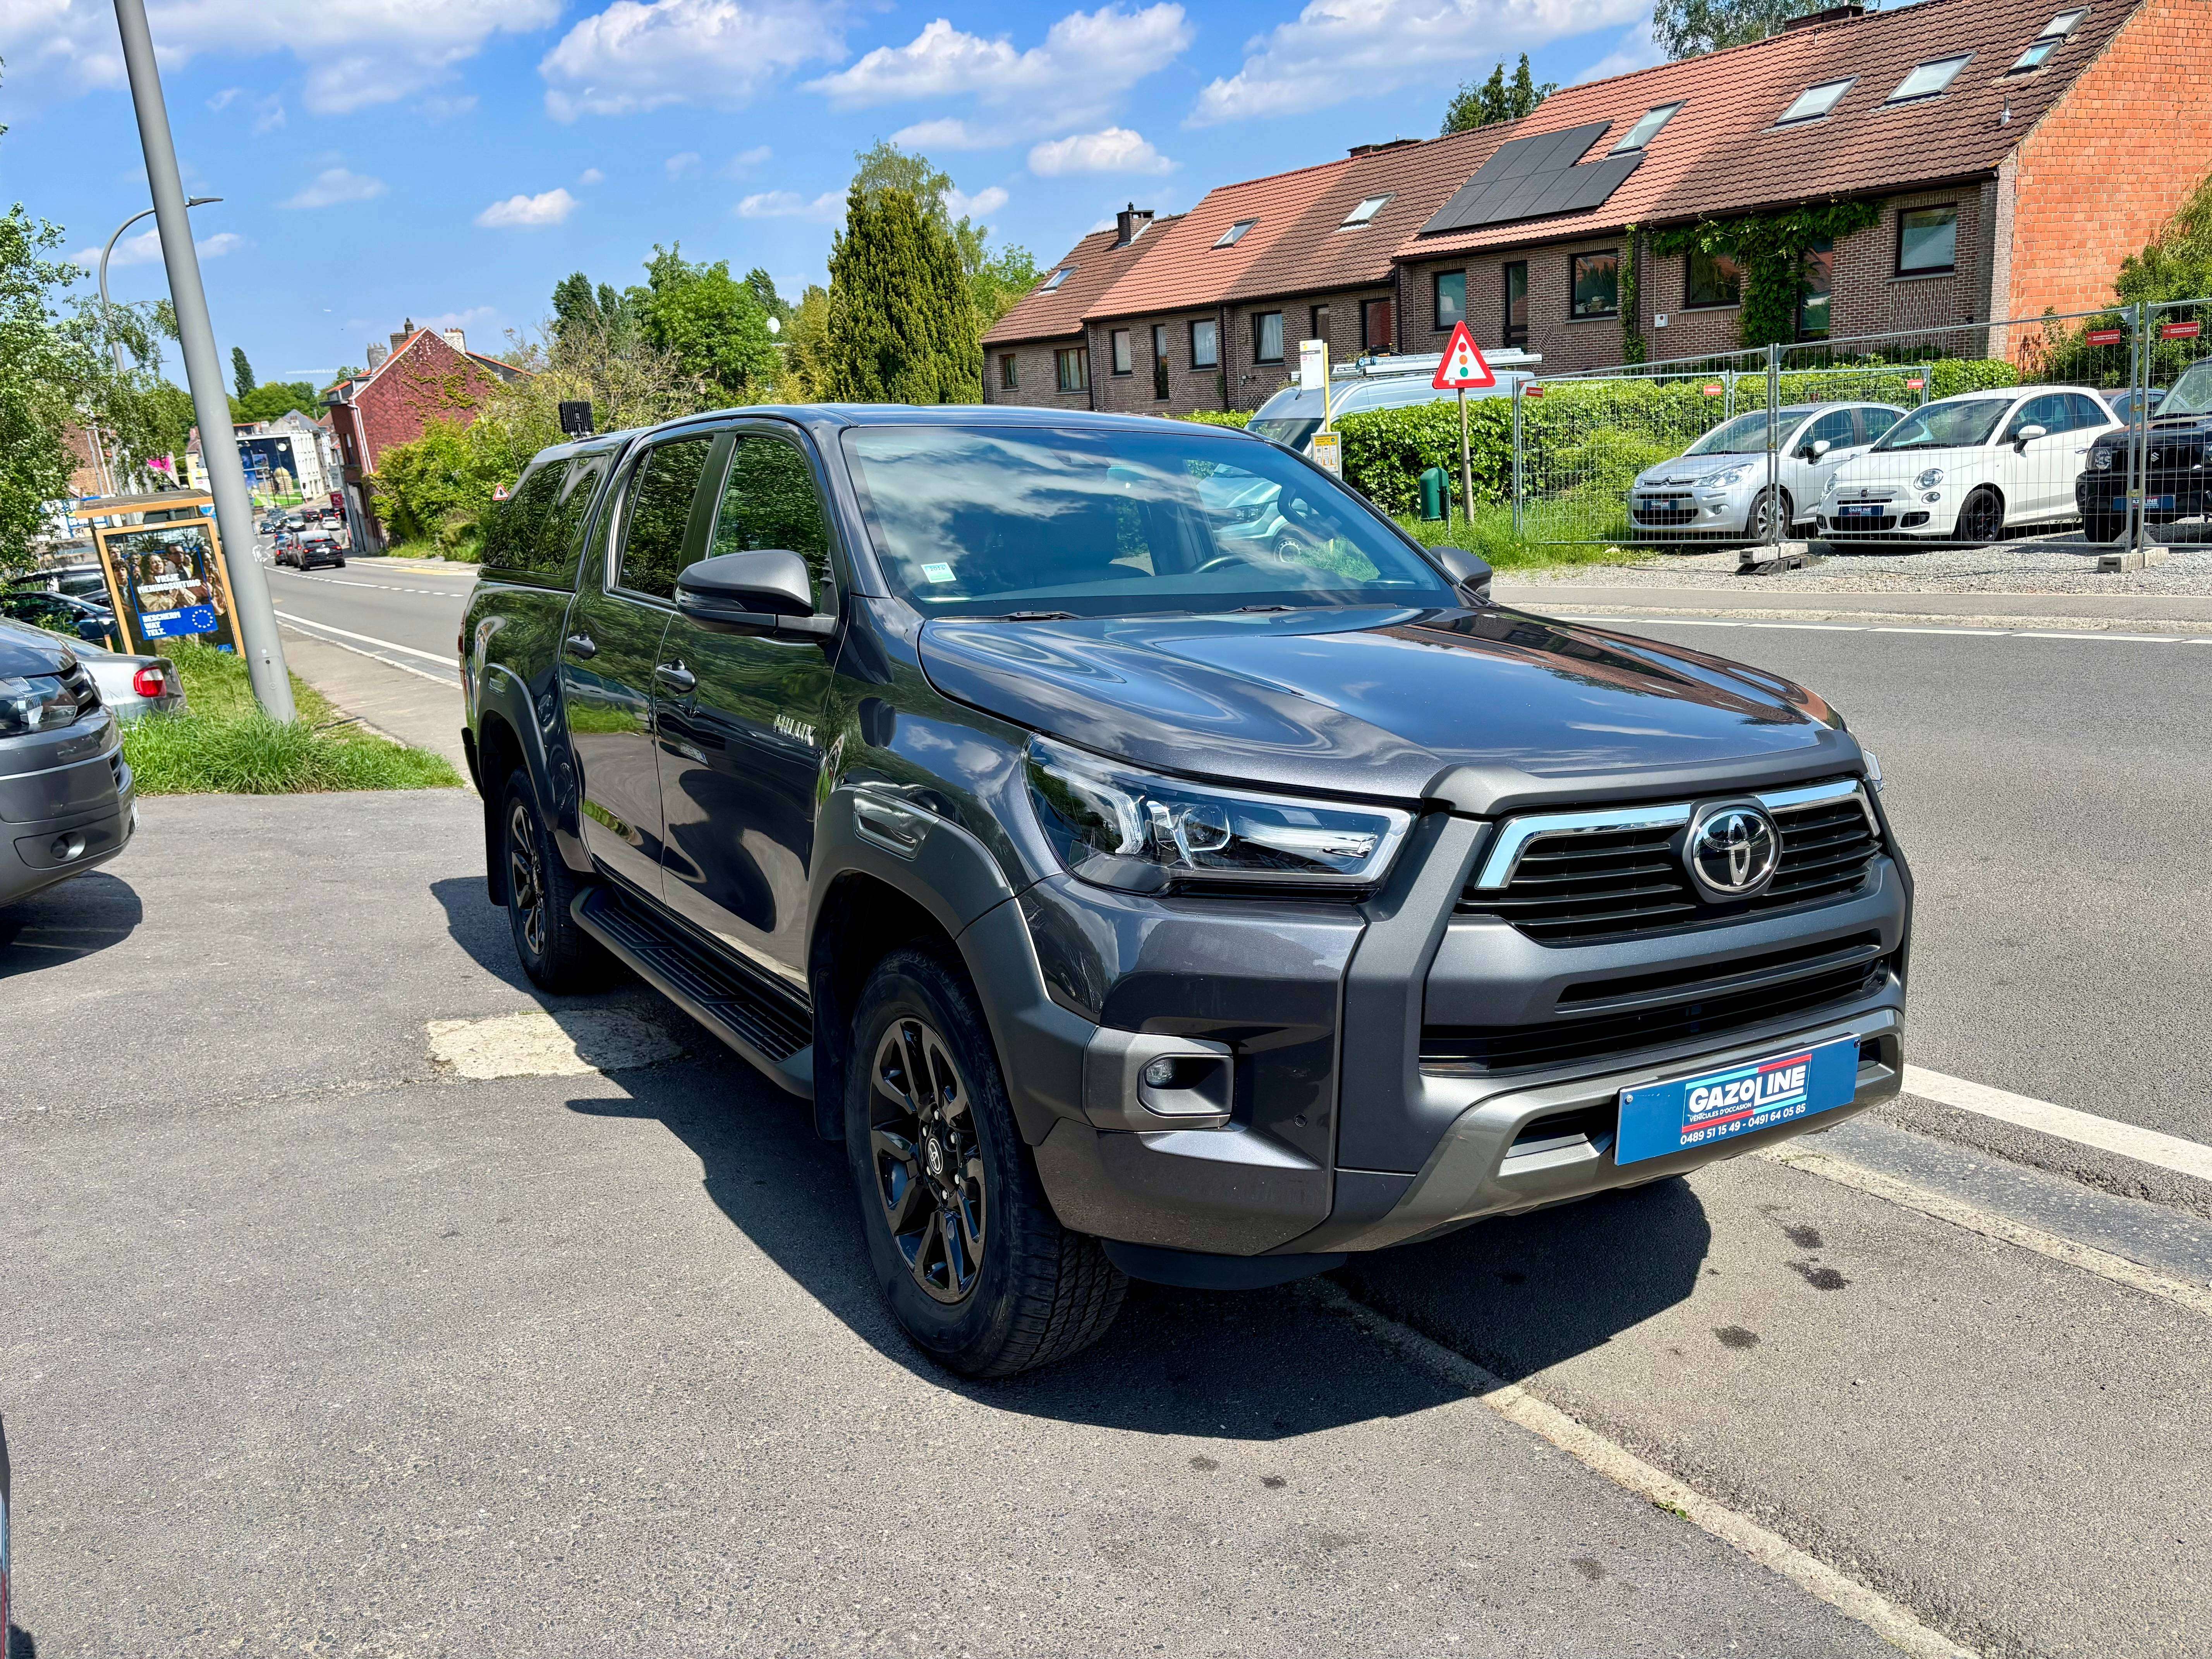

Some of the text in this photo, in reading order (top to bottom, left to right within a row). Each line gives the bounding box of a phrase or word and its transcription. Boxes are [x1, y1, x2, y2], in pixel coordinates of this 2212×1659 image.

[155, 574, 180, 583] VRIJE
[137, 579, 201, 594] MENINGSUITING
[142, 611, 181, 623] BESCHERM
[144, 621, 161, 629] WAT
[145, 628, 167, 637] TELT.
[773, 714, 816, 746] HILUX
[1689, 1065, 1806, 1113] GAZOLINE
[1720, 1102, 1752, 1115] D'OCCASION
[1680, 1130, 1704, 1145] 0489
[1706, 1127, 1716, 1139] 51
[1718, 1125, 1727, 1135] 15
[1729, 1121, 1740, 1132] 49
[1748, 1113, 1769, 1127] 0491
[1770, 1110, 1781, 1121] 64
[1783, 1106, 1794, 1118] 05
[1795, 1103, 1806, 1114] 85
